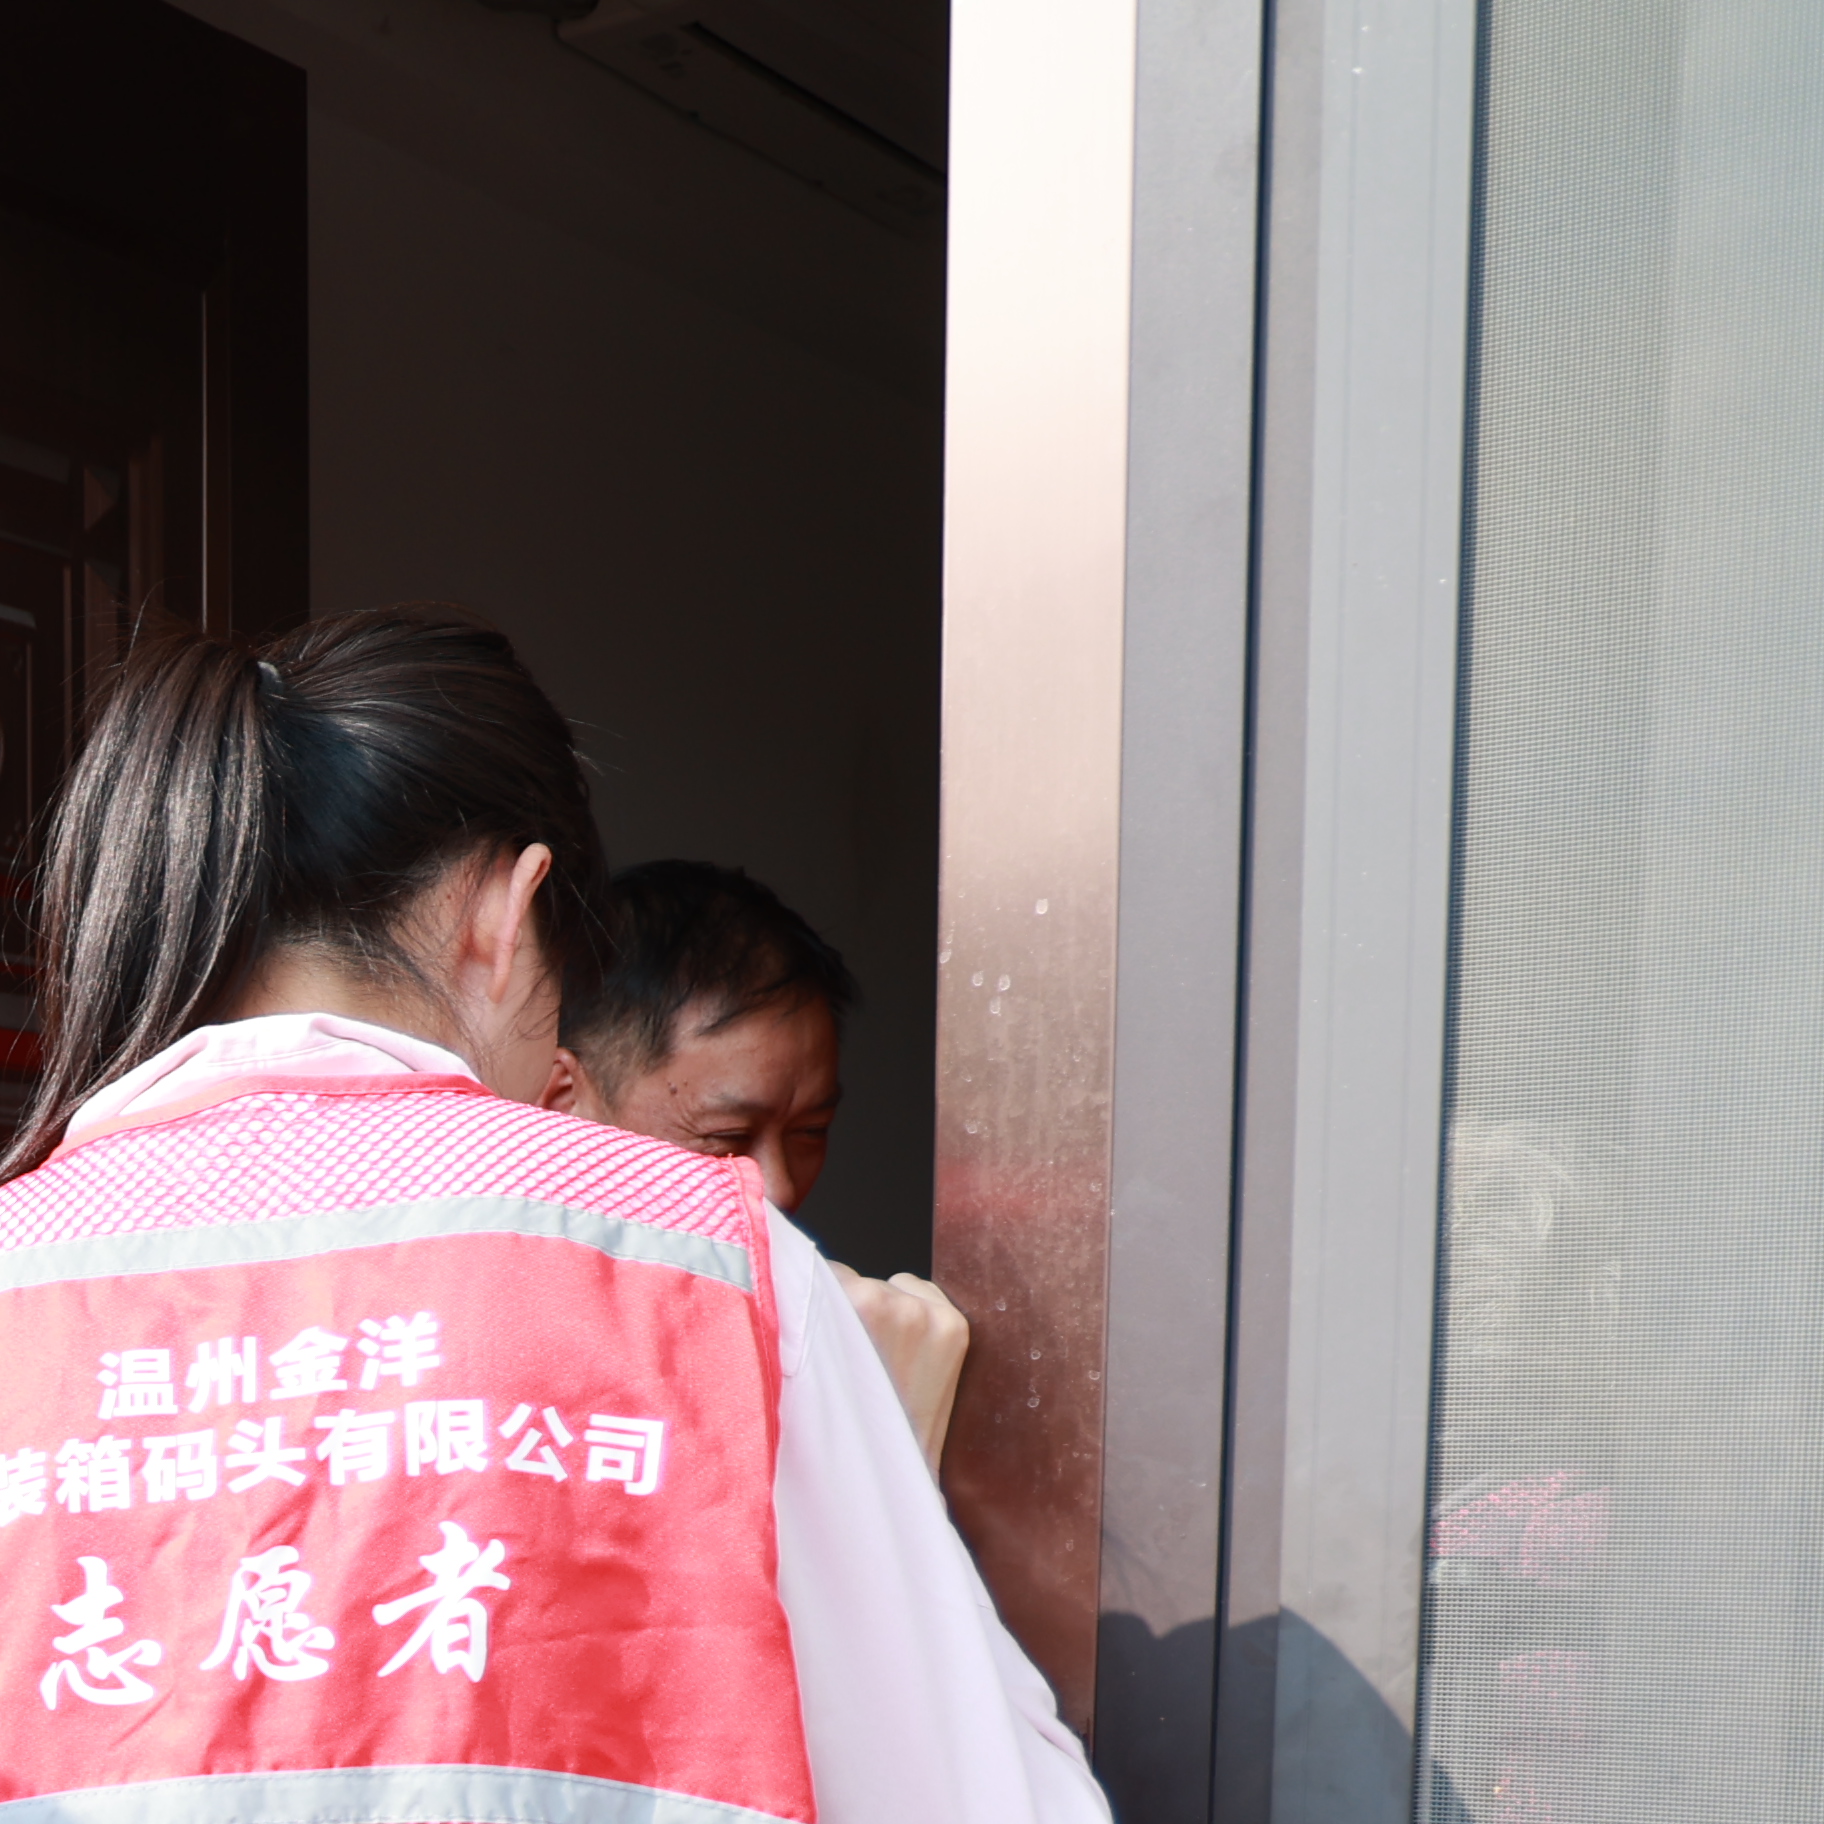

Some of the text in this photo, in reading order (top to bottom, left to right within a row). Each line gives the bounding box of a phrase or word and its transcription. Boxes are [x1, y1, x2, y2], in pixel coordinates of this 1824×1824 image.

[96, 1311, 442, 1420] 温州金洋
[39, 1520, 512, 1710] 志愿者
